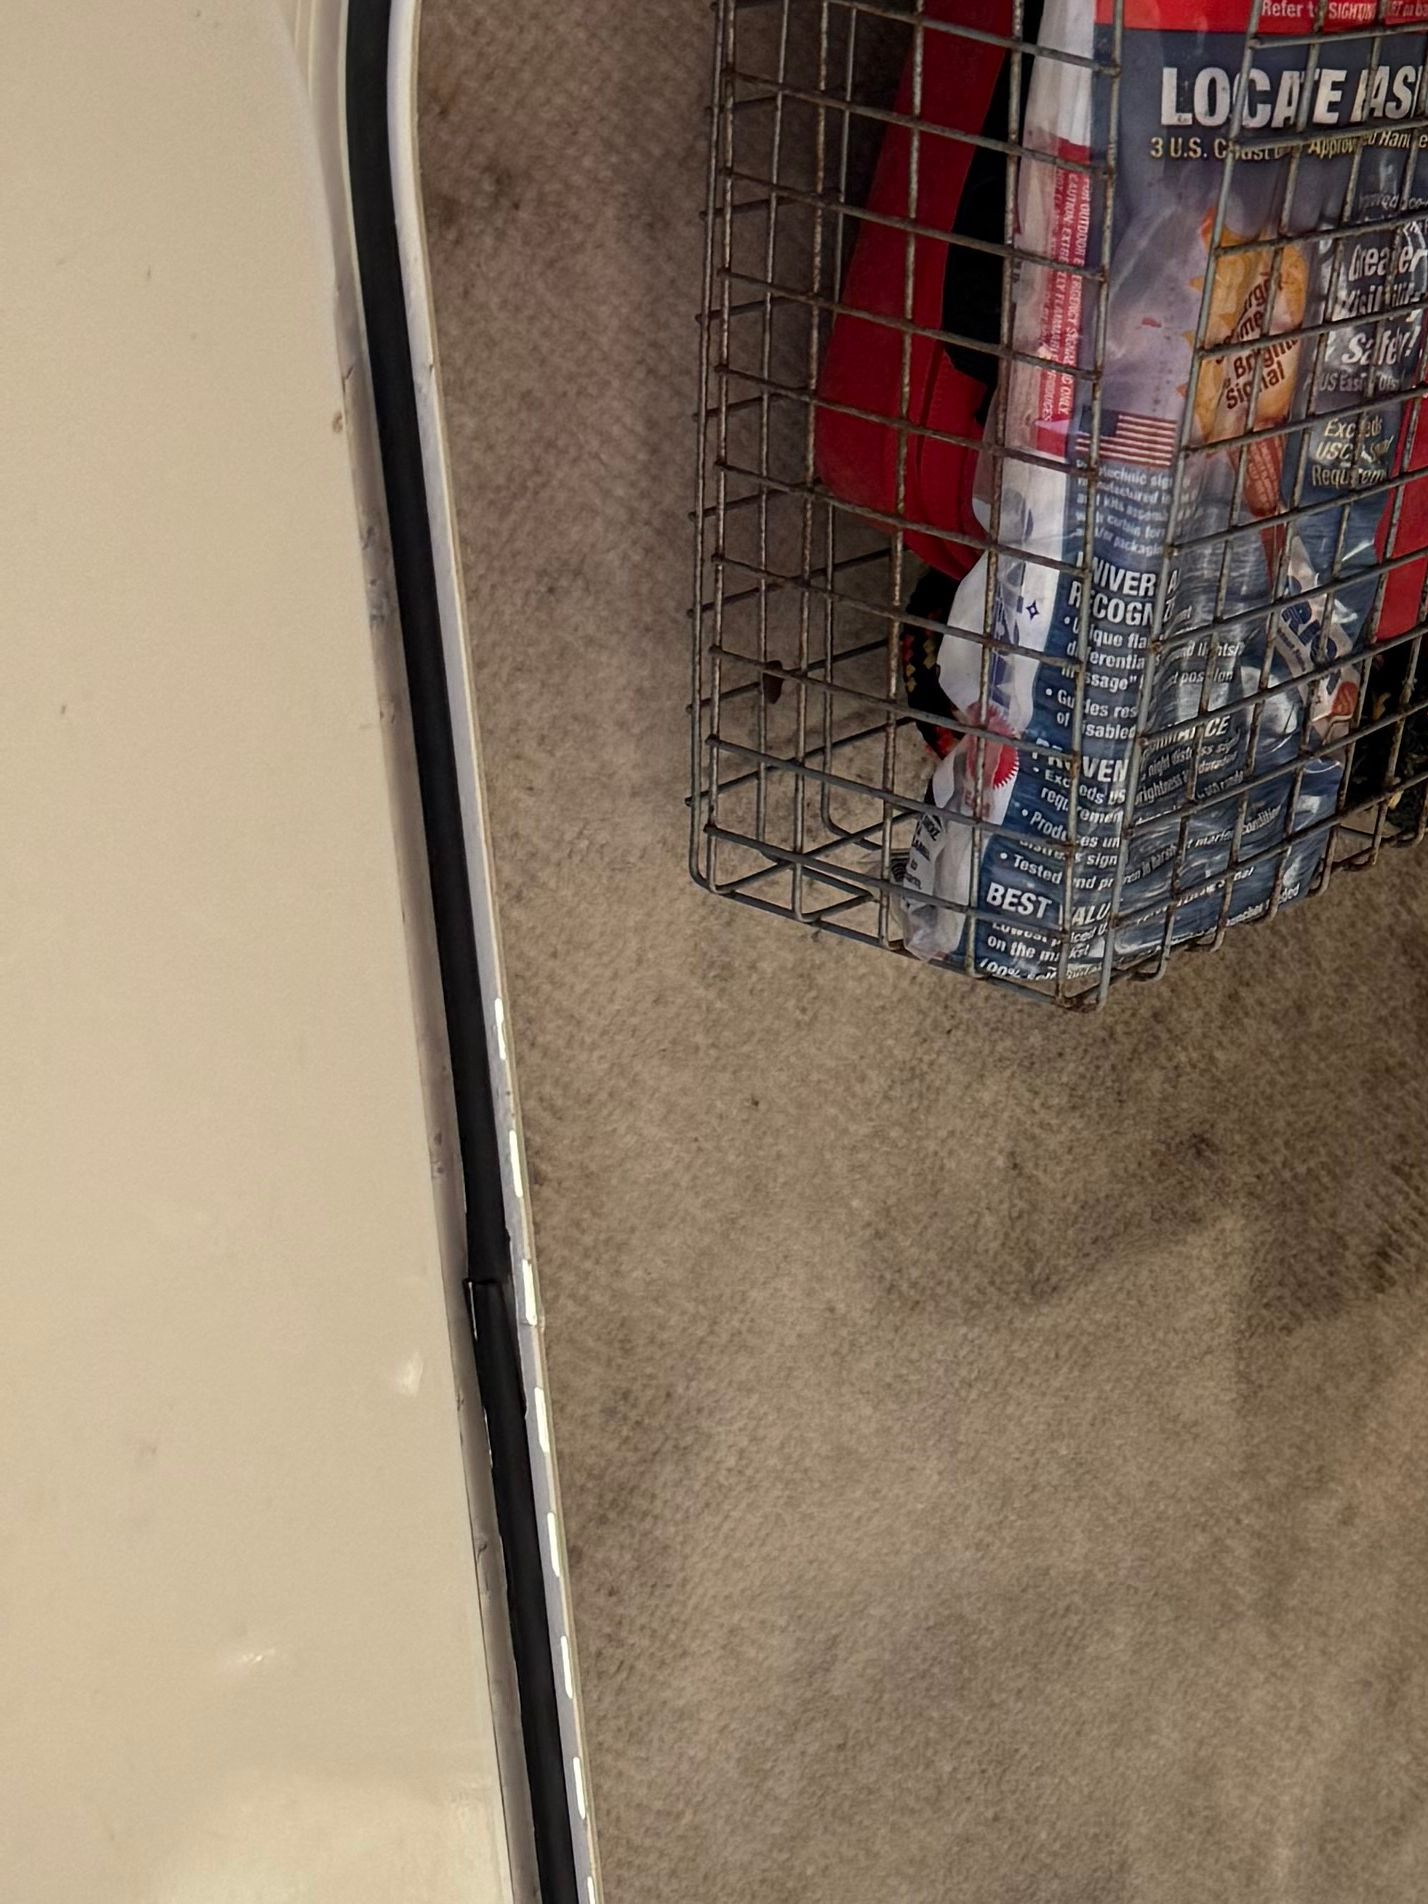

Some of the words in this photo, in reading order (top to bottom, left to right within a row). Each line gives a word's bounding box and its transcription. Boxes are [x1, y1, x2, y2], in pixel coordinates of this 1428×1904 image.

[1261, 0, 1304, 18] Refer
[1151, 137, 1164, 158] 3
[1170, 137, 1207, 159] U.S.
[1214, 138, 1270, 161] Cast
[1055, 227, 1071, 291] EXTREELY
[1348, 245, 1428, 281] Greaer
[1066, 257, 1085, 324] EERGENCY
[1324, 415, 1383, 438] Exceds
[1076, 551, 1181, 597] NIVERA
[1073, 616, 1123, 648] Uique
[1061, 667, 1138, 693] mssage"
[1057, 689, 1109, 718] Gues
[1082, 720, 1137, 740] isabled
[1032, 737, 1129, 783] PRVEN
[1044, 769, 1105, 804] Exceds
[1030, 811, 1099, 848] Produes
[1013, 853, 1063, 885] Tested
[1073, 871, 1096, 890] nd
[1086, 852, 1118, 869] sign
[986, 882, 1052, 919] BEST
[1059, 902, 1112, 932] ALU
[987, 936, 1007, 953] on
[1009, 940, 1037, 959] the
[1039, 943, 1090, 962] maket
